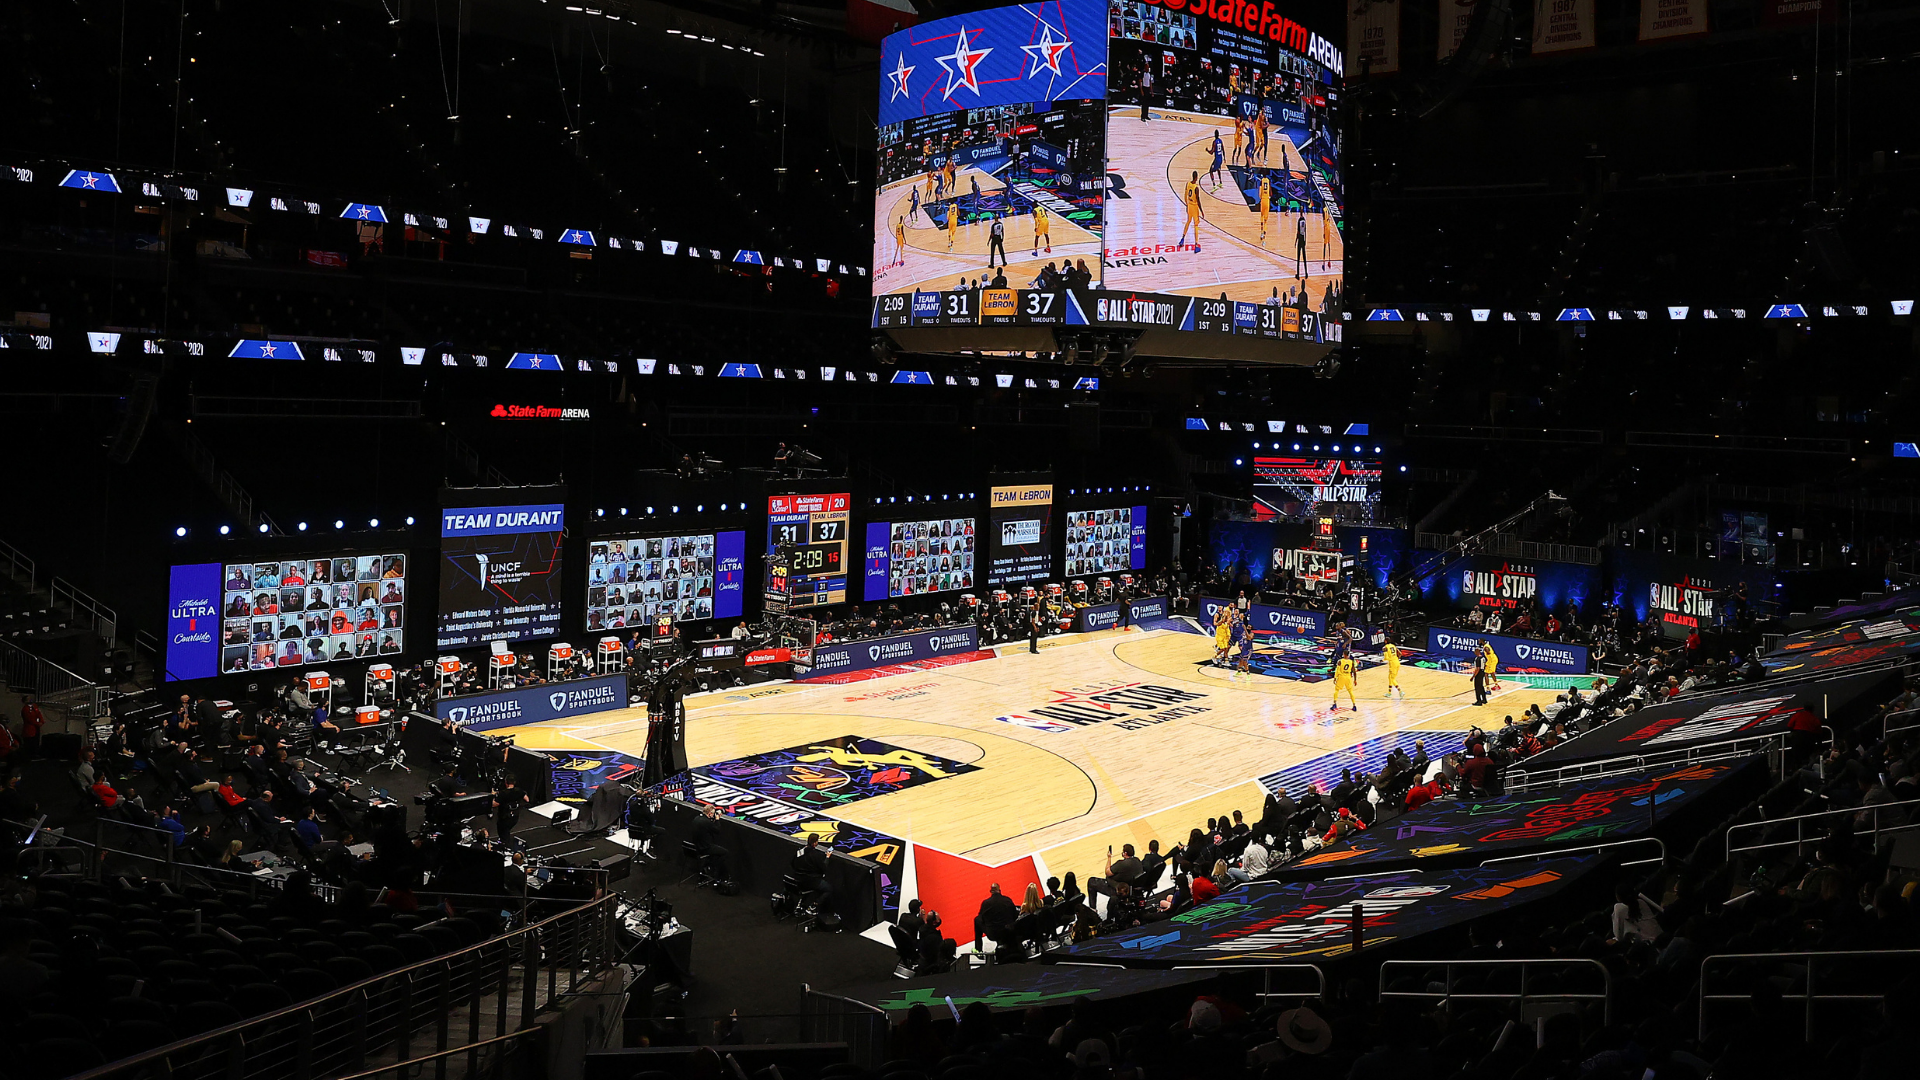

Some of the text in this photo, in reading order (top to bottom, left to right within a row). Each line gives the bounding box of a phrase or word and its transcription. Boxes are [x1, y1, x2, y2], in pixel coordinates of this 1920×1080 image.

[1552, 0, 1576, 12] 1987
[1777, 1, 1822, 14] CHAMPIONS
[1550, 13, 1578, 24] CENTRAL
[1658, 8, 1688, 20] DIVISION
[1550, 23, 1578, 34] DIVISION
[1652, 17, 1694, 30] CHAMPIONS
[1364, 28, 1384, 40] 1970
[1544, 32, 1582, 44] CHAMPIONS
[1360, 39, 1386, 50] WESTERN
[1308, 31, 1344, 78] ARENA
[17, 168, 32, 182] 2021
[184, 187, 198, 200] 2021
[308, 202, 320, 214] 2021
[918, 295, 936, 304] TEAM
[988, 293, 1010, 301] TEAM
[884, 297, 904, 312] 2:09
[914, 302, 940, 312] DURANT
[948, 294, 969, 316] 31
[1026, 293, 1054, 314] 37
[1239, 305, 1254, 314] TEAM
[1108, 300, 1174, 325] ALL STAR 2021
[1202, 302, 1226, 318] 2:09
[1734, 310, 1746, 318] 2021
[1855, 306, 1868, 316] 2021
[900, 316, 906, 324] 15
[1236, 312, 1258, 322] DURANT
[1262, 308, 1276, 328] 31
[1198, 320, 1210, 330] 1ST
[1222, 322, 1230, 332] 15
[1302, 314, 1314, 333] 37
[36, 336, 52, 350] 2021
[188, 342, 204, 356] 2021
[362, 352, 376, 363] 2021
[561, 408, 590, 418] ARENA
[993, 490, 1050, 502] TEAM LeBRON
[1322, 487, 1367, 502] ALL STAR
[834, 498, 845, 508] 20
[444, 510, 562, 530] TEAM DURANT
[780, 526, 797, 542] 31
[820, 523, 838, 540] 37
[1321, 525, 1332, 534] 14
[794, 550, 822, 569] 2:09
[828, 552, 839, 562] 15
[866, 550, 888, 559] ULTRA
[490, 562, 521, 572] UNCF
[718, 562, 742, 572] ULTRA
[772, 566, 787, 576] 2:09
[1511, 564, 1534, 573] 2021
[773, 577, 786, 592] 14
[1475, 572, 1536, 599] ALL STAR
[1691, 578, 1711, 588] 2021
[1660, 585, 1713, 618] ALL STAR
[172, 606, 216, 618] ULTRA
[1140, 604, 1161, 613] FANDUEL
[658, 617, 672, 626] 2:09
[1097, 610, 1120, 622] FANDUEL
[1282, 614, 1316, 625] FANDUEL
[1664, 612, 1698, 628] ATLANTA
[659, 626, 668, 635] 14
[174, 632, 212, 644] Courtside
[941, 633, 970, 645] FANDUEL
[882, 641, 913, 653] FANDUEL
[941, 640, 971, 650] SPORTSBOOK
[816, 651, 850, 663] FANDUEL
[882, 649, 914, 660] SPORTSBOOK
[1532, 647, 1574, 660] FANDUEL
[816, 658, 851, 670] SPORTSBOOK
[1532, 655, 1575, 666] SPORTSBOOK
[568, 686, 615, 701] FANDUEL
[470, 700, 521, 716] FANDUEL
[569, 696, 615, 709] SPORTSBOOK
[1028, 684, 1210, 726] ALL STAR
[471, 710, 522, 724] SPORTSBOOK
[1112, 705, 1212, 730] ATLANTA
[674, 726, 680, 741] TV
